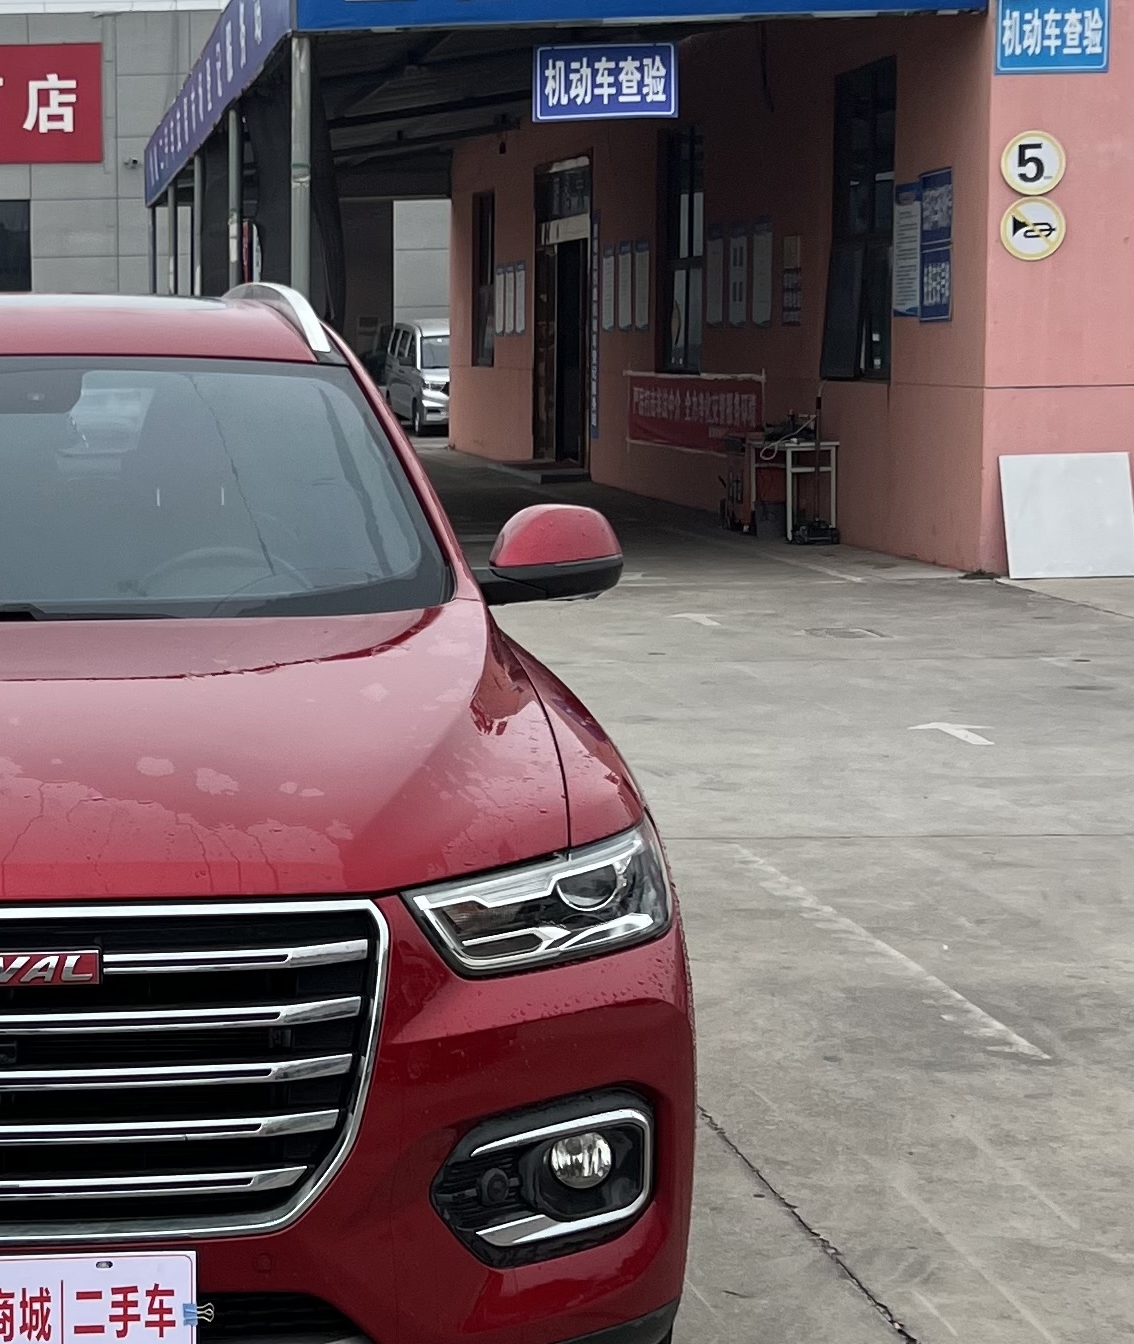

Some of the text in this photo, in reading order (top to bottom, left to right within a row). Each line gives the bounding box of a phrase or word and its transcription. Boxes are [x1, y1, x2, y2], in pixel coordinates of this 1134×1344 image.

[1001, 7, 1104, 57] 机动车查验
[544, 54, 668, 107] 机动车查验
[1017, 142, 1045, 183] 5
